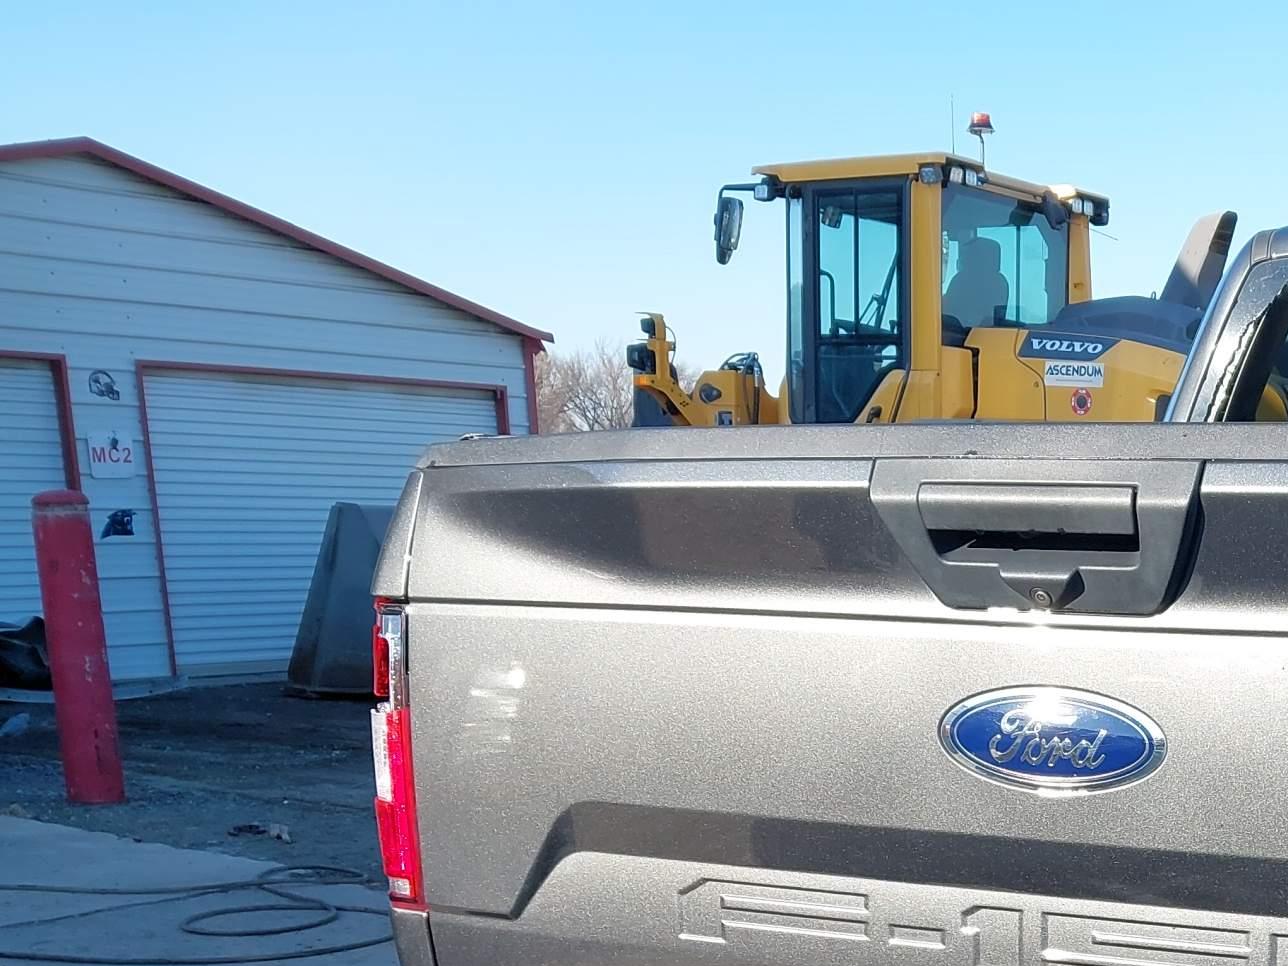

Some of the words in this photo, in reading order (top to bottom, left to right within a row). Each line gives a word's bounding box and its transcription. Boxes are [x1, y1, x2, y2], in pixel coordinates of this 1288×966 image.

[1031, 338, 1103, 354] VOLVO
[1046, 364, 1103, 377] ASCENDUM
[91, 446, 132, 464] MC2
[988, 707, 1108, 770] Ford
